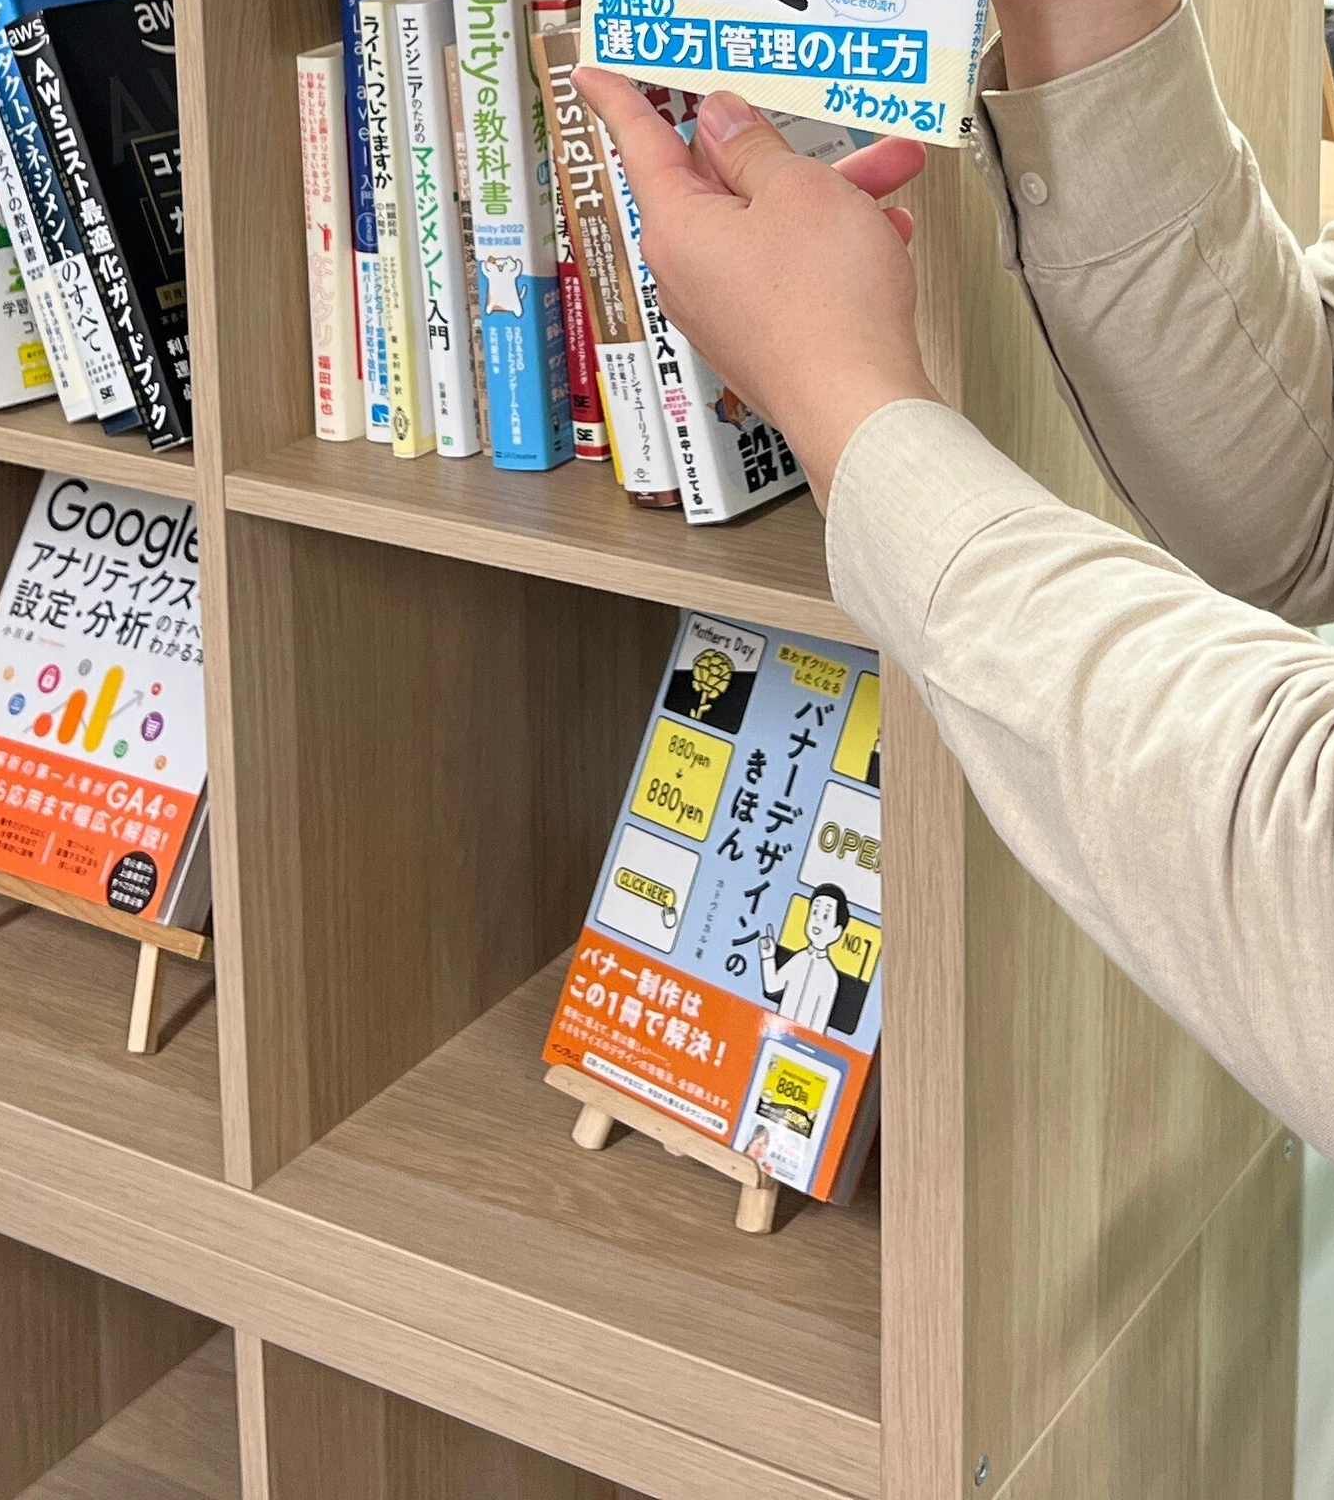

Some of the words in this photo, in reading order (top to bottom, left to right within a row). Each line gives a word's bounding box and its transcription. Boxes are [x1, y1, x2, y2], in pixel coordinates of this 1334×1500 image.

[7, 17, 46, 49] aws
[133, 0, 175, 35] aw
[598, 18, 710, 67] 選び方
[719, 26, 923, 80] 管理の仕方
[363, 14, 393, 190] ライト、ついてますか
[824, 81, 946, 134] がわかる!
[403, 17, 449, 351] エンジニアのためのマネジメント入門
[35, 56, 167, 431] AWSコスト最適化ガイドブック
[499, 223, 524, 234] 2022
[576, 428, 594, 442] SE
[27, 541, 197, 610] アナリティクス
[9, 578, 153, 650] 設定・分析
[734, 636, 757, 663] Day
[793, 669, 843, 695] したくなる
[667, 733, 711, 769] 880yen
[646, 777, 704, 825] 880yen
[717, 747, 768, 863] きほん
[725, 701, 835, 977] バナーデザインの
[818, 820, 880, 874] OPE
[619, 871, 645, 896] CLICK
[579, 946, 703, 1019] バナー制作は
[569, 973, 728, 1067] この1冊で解決!
